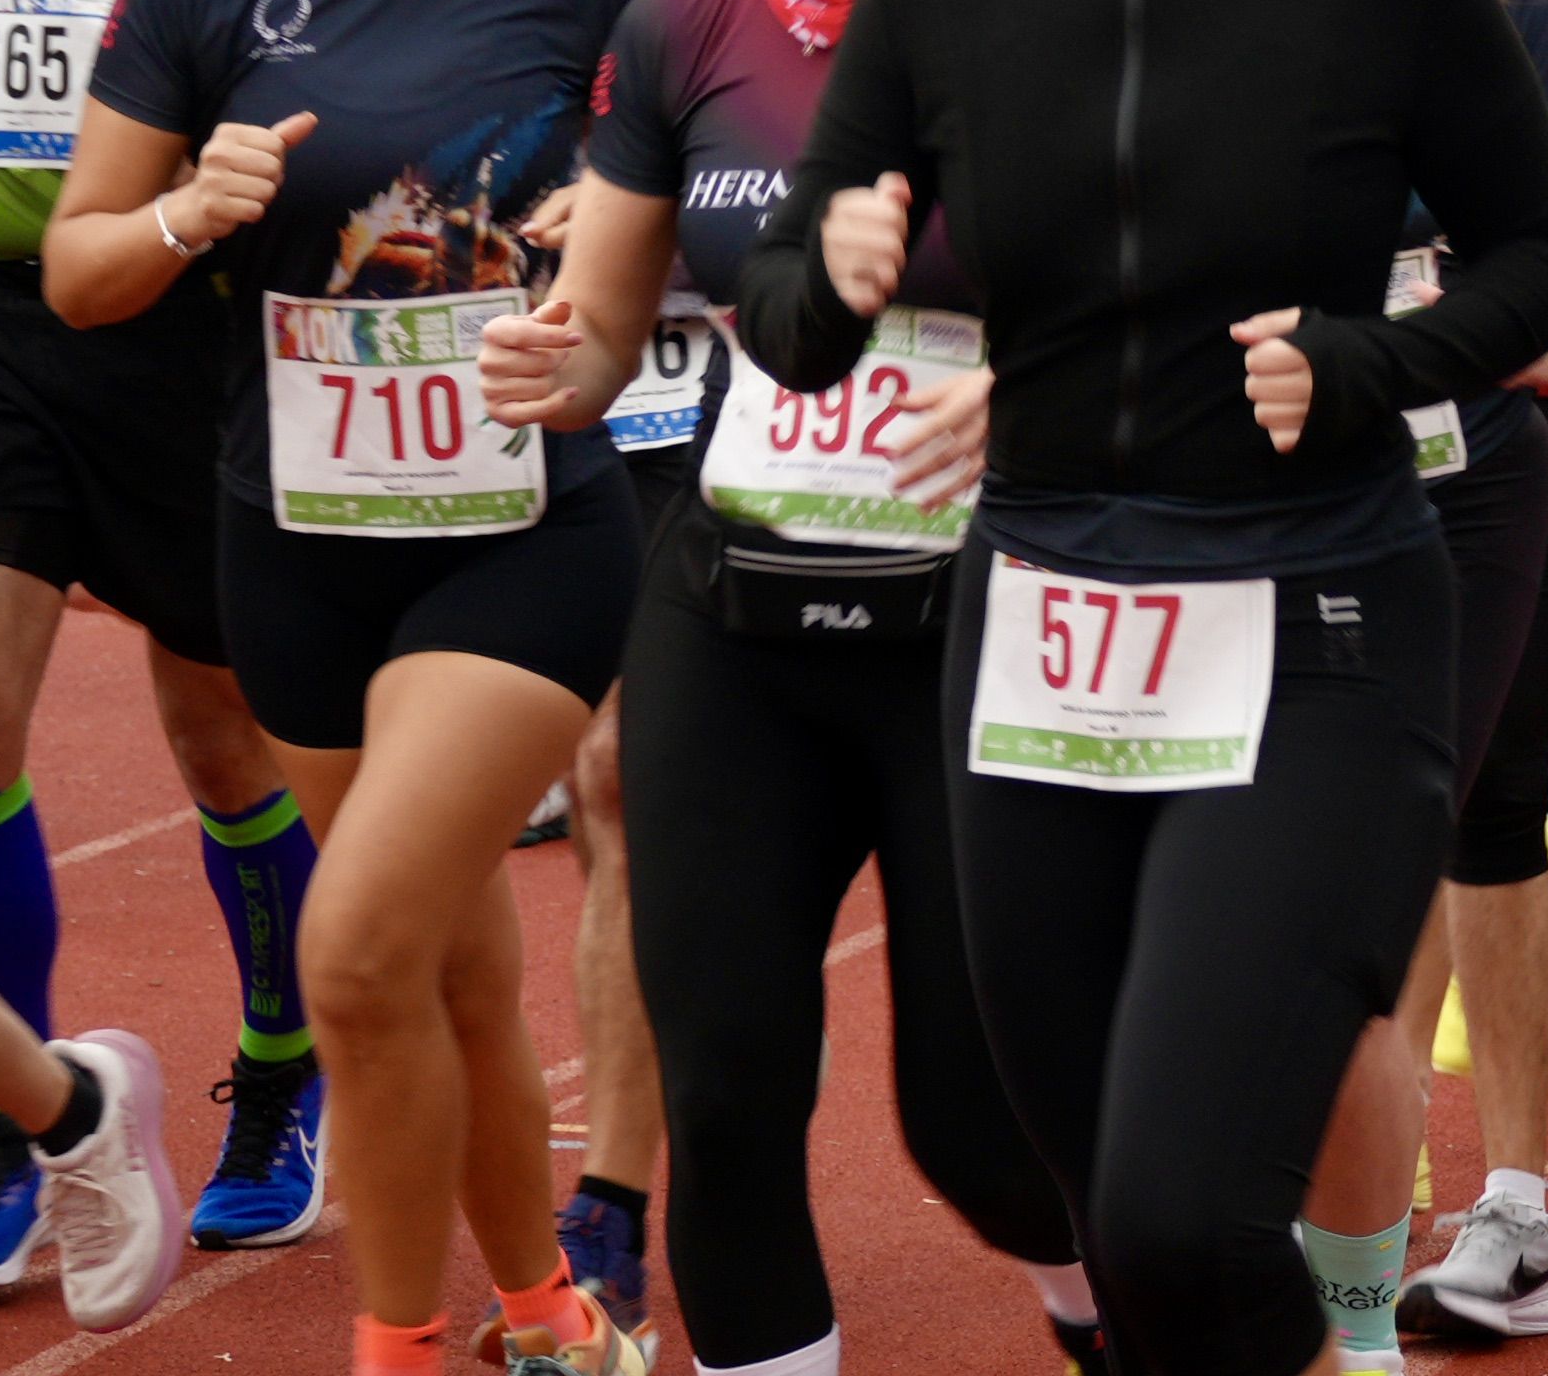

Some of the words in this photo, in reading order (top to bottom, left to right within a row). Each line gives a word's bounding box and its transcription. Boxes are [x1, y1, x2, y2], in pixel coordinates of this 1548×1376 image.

[287, 304, 360, 366] 10K
[320, 373, 464, 462] 710
[769, 365, 910, 455] 592
[801, 603, 873, 630] FILA
[1040, 585, 1183, 696] 577
[1314, 1274, 1385, 1298] STAY
